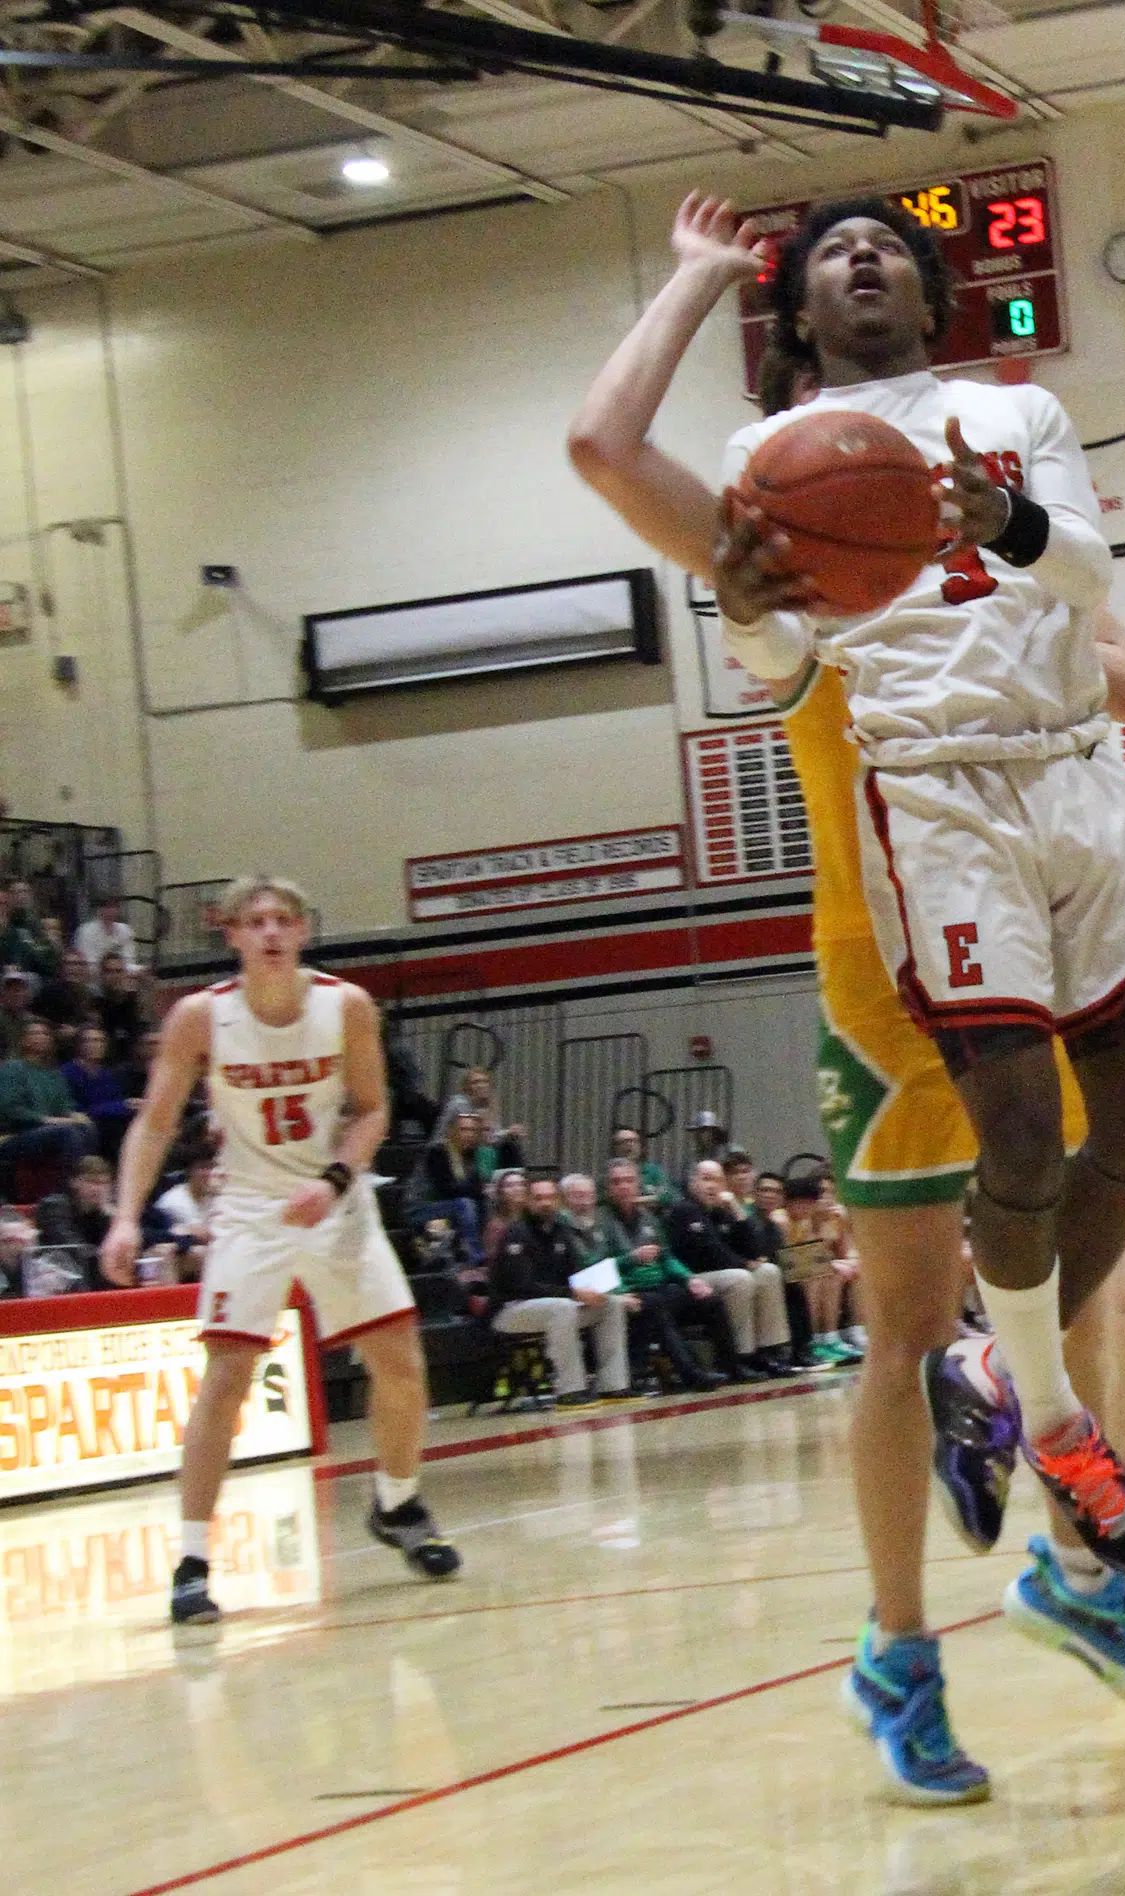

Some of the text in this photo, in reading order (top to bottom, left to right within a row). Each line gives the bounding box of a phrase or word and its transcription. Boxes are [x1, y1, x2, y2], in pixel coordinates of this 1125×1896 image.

[987, 198, 1046, 249] 23
[1009, 299, 1036, 337] 0
[943, 922, 983, 988] E
[261, 1092, 314, 1145] 15
